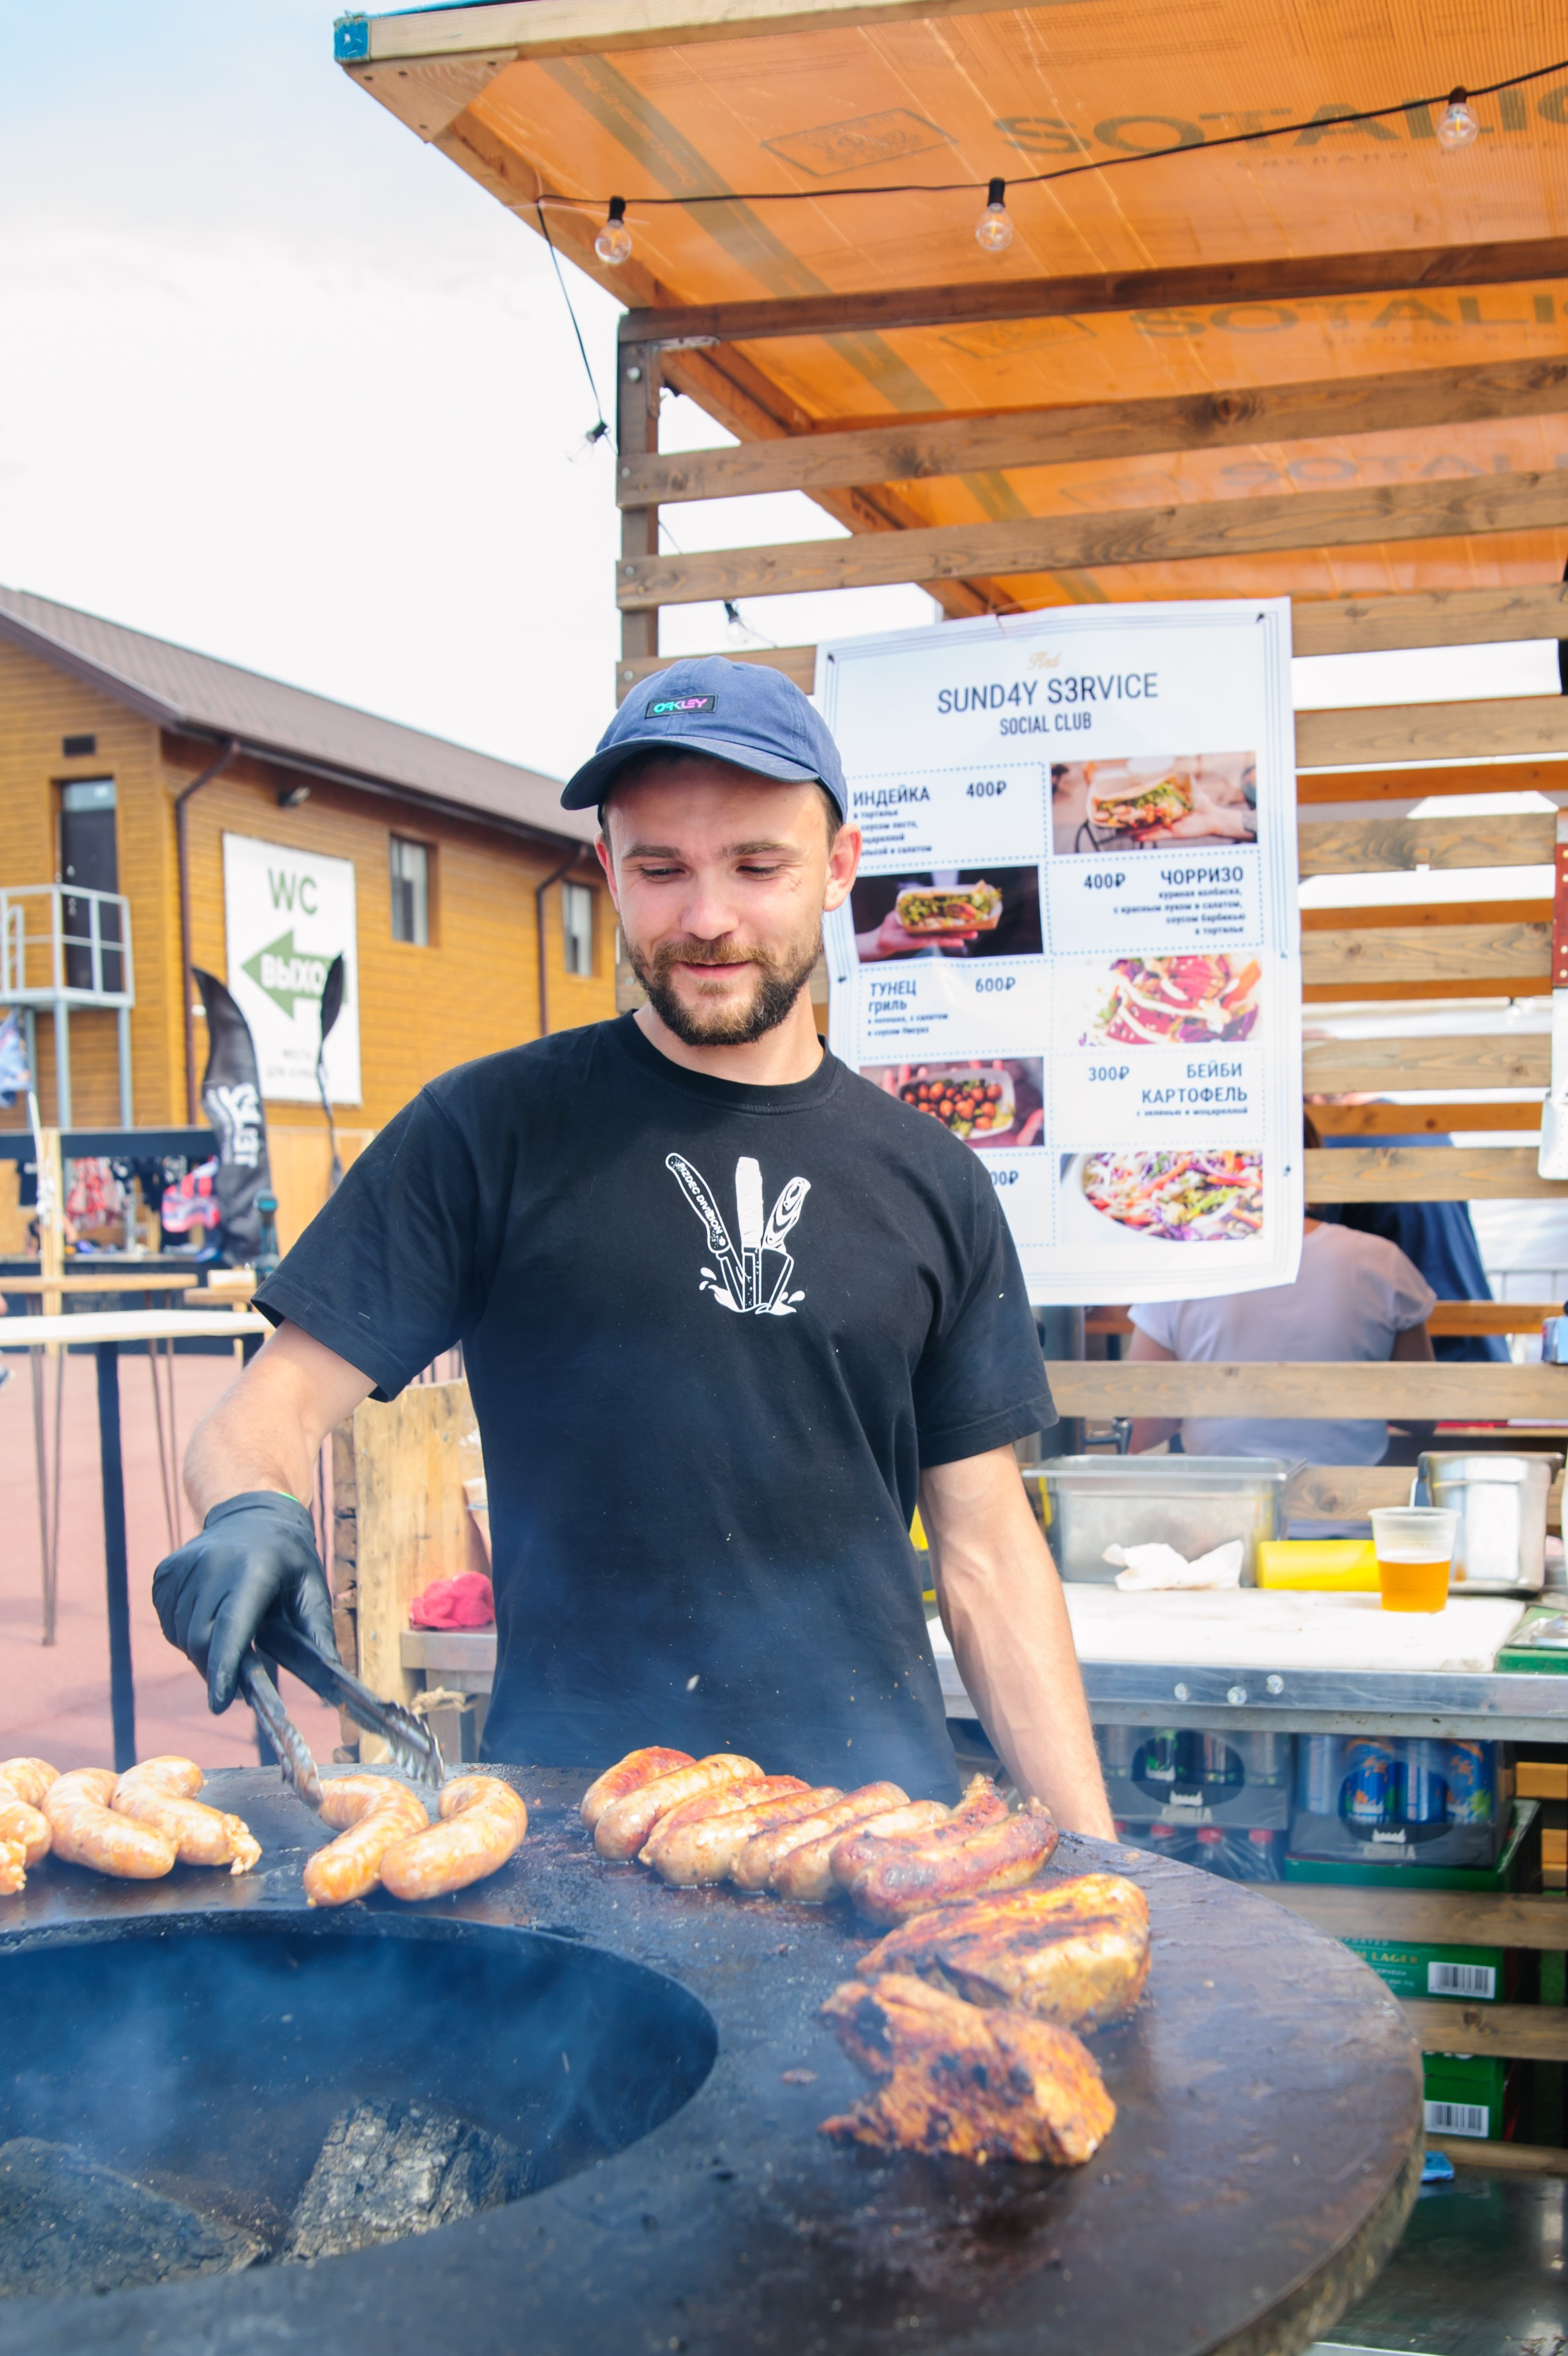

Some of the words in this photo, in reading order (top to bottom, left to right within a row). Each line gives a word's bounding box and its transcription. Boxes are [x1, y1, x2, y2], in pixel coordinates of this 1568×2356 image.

[1129, 294, 1568, 338] SOTALI
[937, 680, 1039, 714] SUND4Y
[1048, 672, 1158, 704] S3RVICE
[654, 698, 707, 713] OAKLEY
[1000, 715, 1050, 736] SOCIAL
[1055, 712, 1092, 732] CLUB
[853, 785, 931, 808] ИНДЕЙКА
[1161, 866, 1243, 885] ЧОРРИЗО
[268, 867, 317, 915] WC
[261, 953, 325, 996] ВЫХО
[870, 980, 917, 997] ТУНЕЦ
[868, 1000, 908, 1015] гриль
[1187, 1060, 1242, 1078] БЕЙБИ
[1142, 1087, 1247, 1104] КАРТОФЕЛЬ
